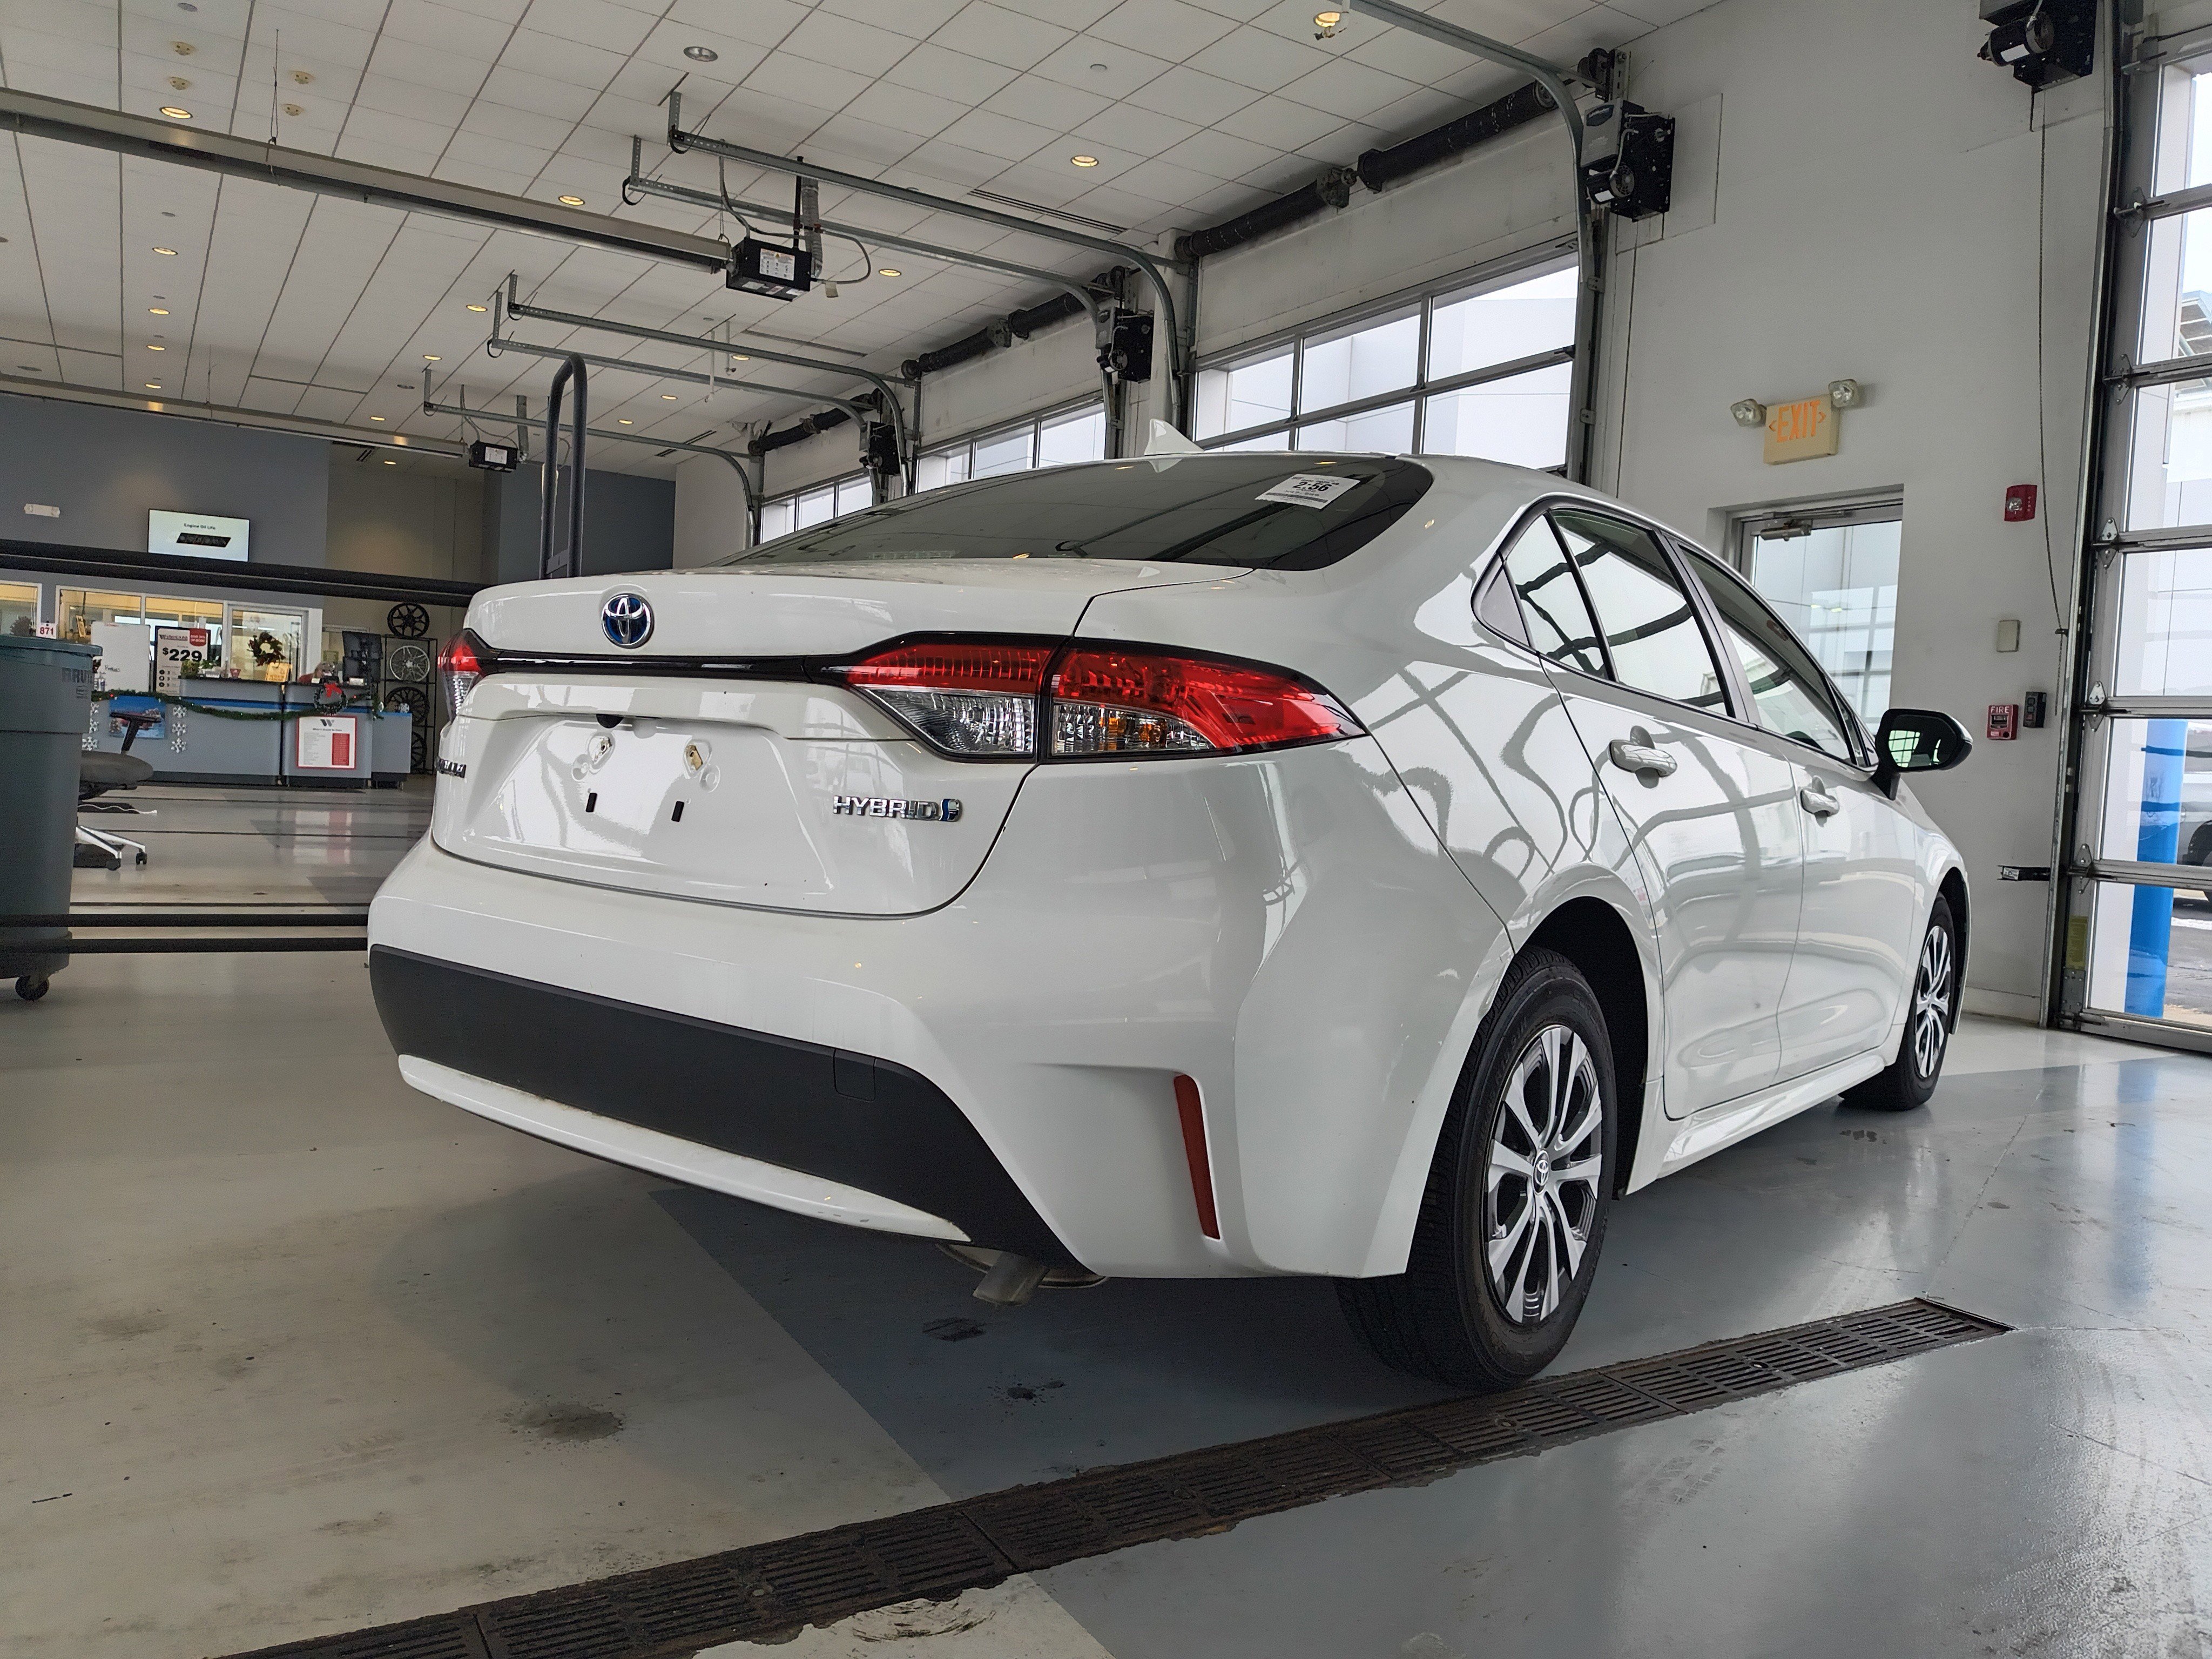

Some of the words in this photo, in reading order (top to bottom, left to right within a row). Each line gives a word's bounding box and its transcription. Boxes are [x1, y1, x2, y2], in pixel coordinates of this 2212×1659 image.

[1777, 400, 1820, 442] EXIT
[39, 626, 53, 635] 871
[163, 648, 202, 662] $229
[833, 795, 940, 820] HYBRID
